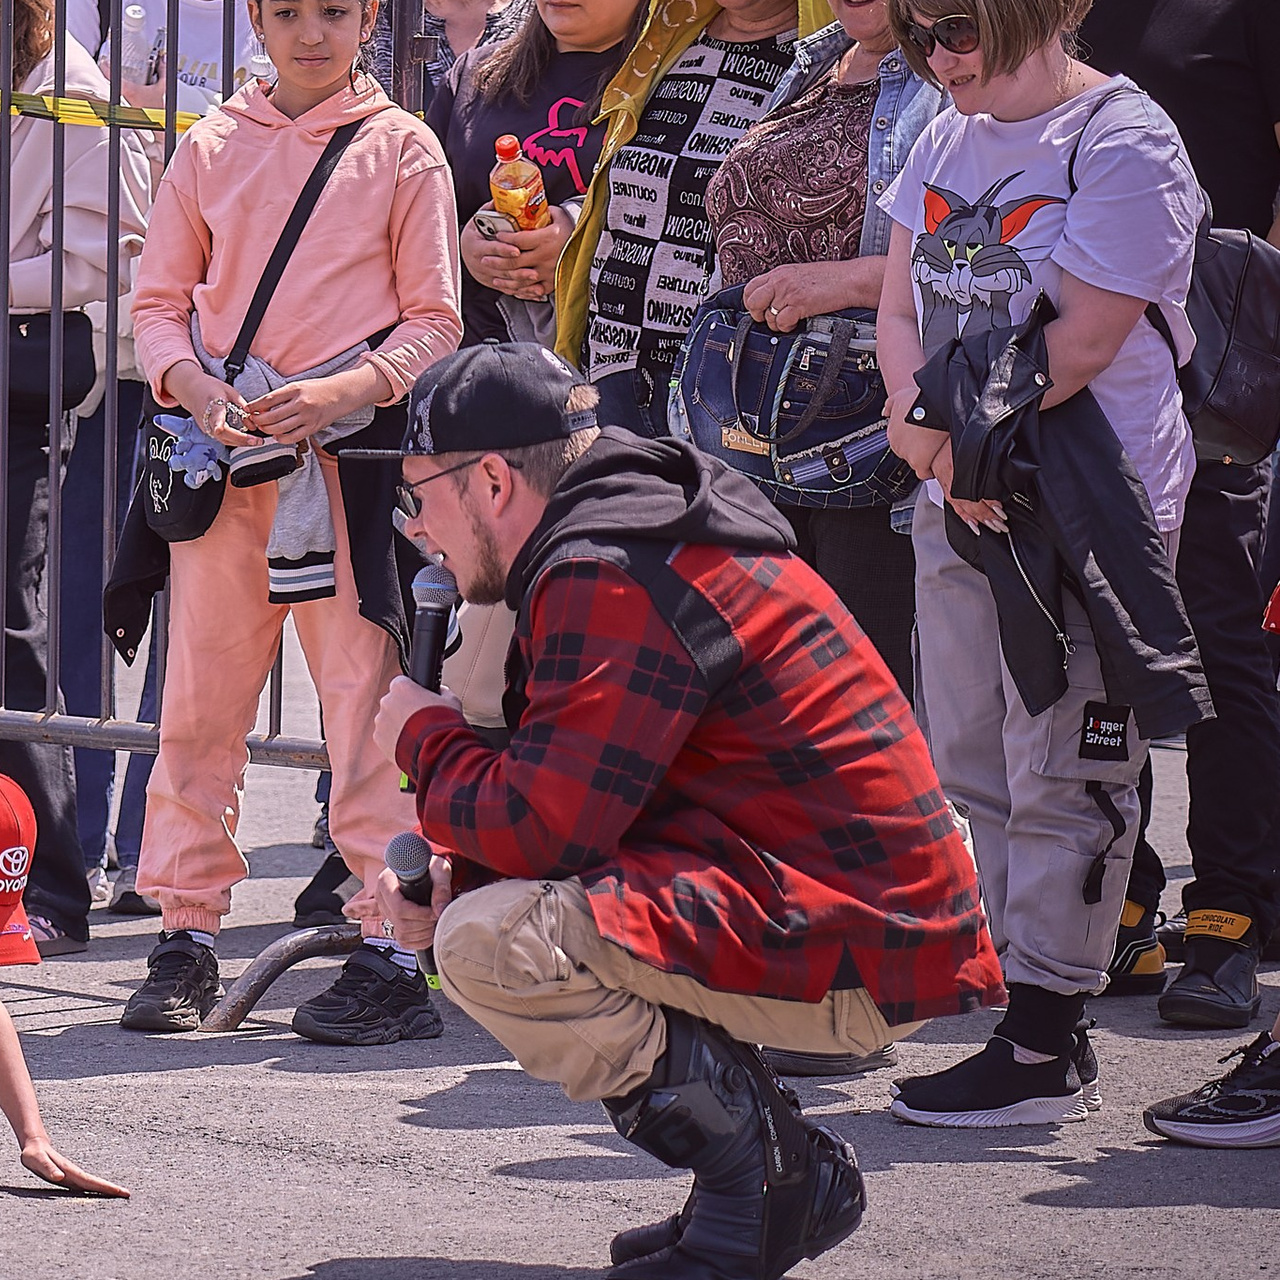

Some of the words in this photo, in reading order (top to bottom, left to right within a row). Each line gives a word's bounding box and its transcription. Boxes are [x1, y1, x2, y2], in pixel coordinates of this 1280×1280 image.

[177, 68, 207, 88] OUR
[1085, 732, 1123, 748] Street
[1201, 913, 1236, 926] CHOCOLATE
[1208, 923, 1224, 933] RIDE
[763, 1105, 778, 1141] COMPOSITE
[772, 1146, 783, 1173] CARBON
